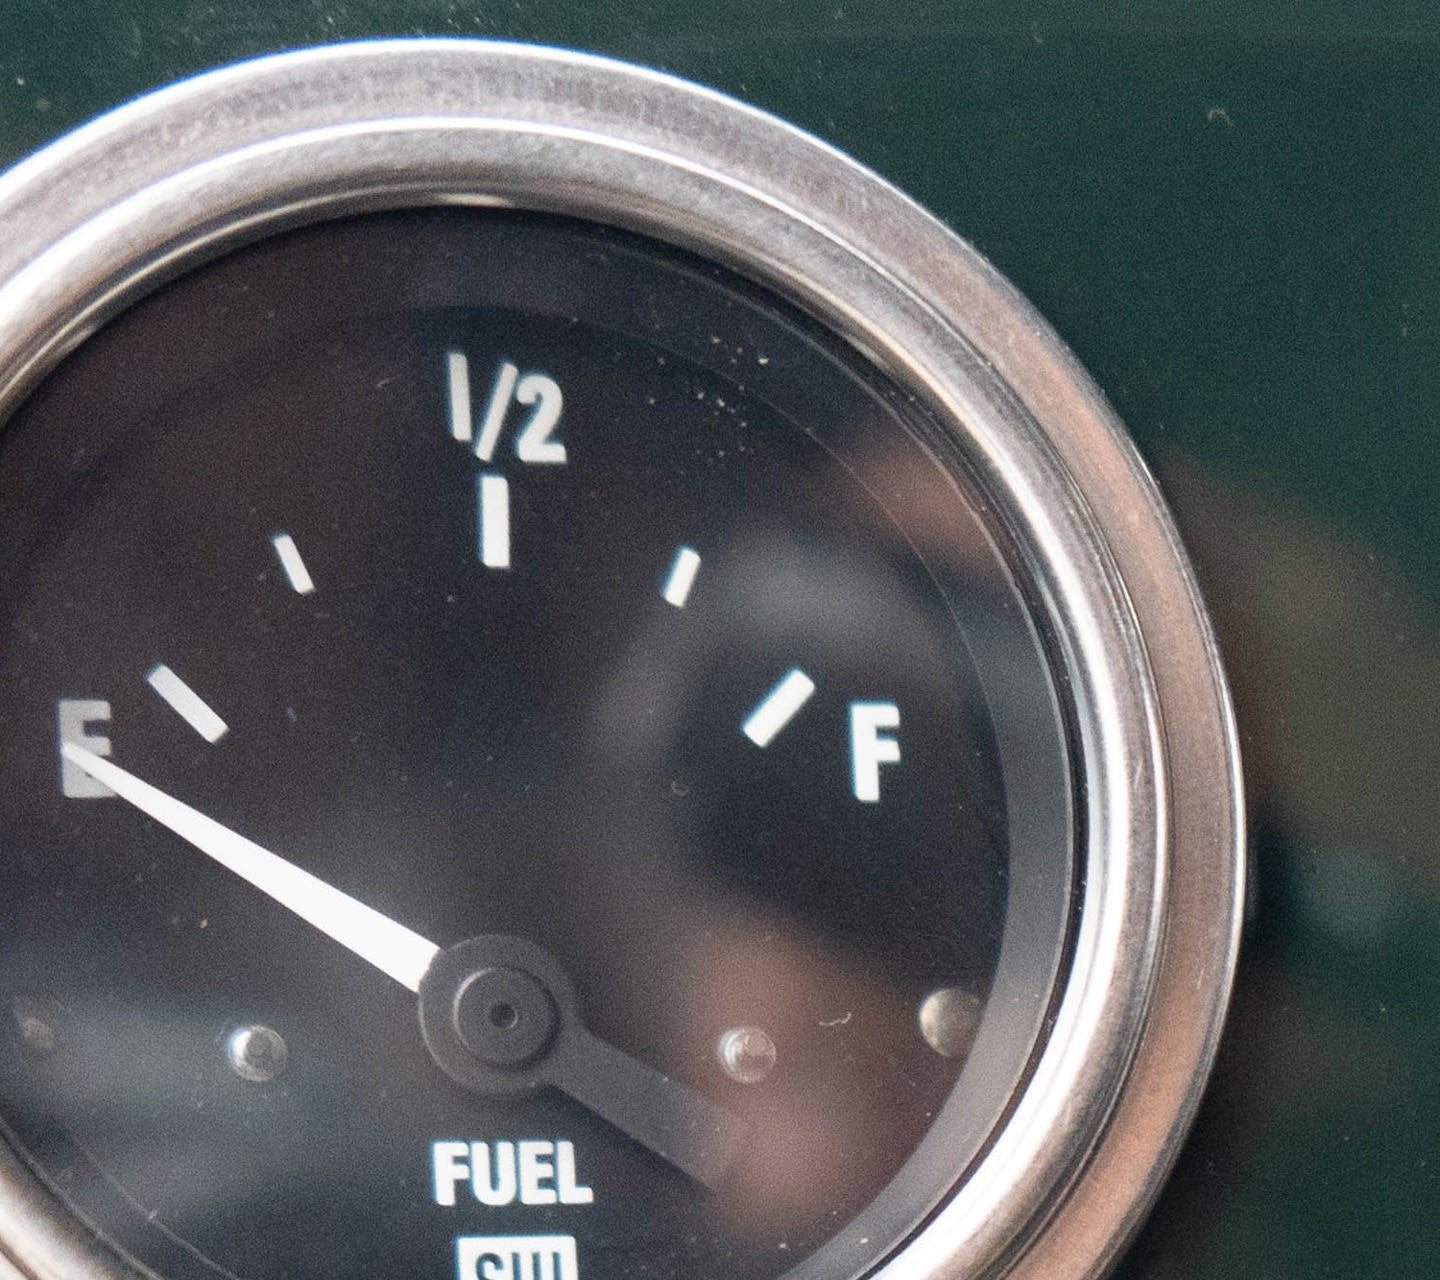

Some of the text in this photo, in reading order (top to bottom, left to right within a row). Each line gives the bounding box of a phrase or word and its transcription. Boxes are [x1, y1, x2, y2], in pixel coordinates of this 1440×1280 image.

[447, 350, 567, 463] 1/2
[57, 698, 116, 801] E
[849, 701, 901, 802] F
[430, 1139, 594, 1206] FUEL
